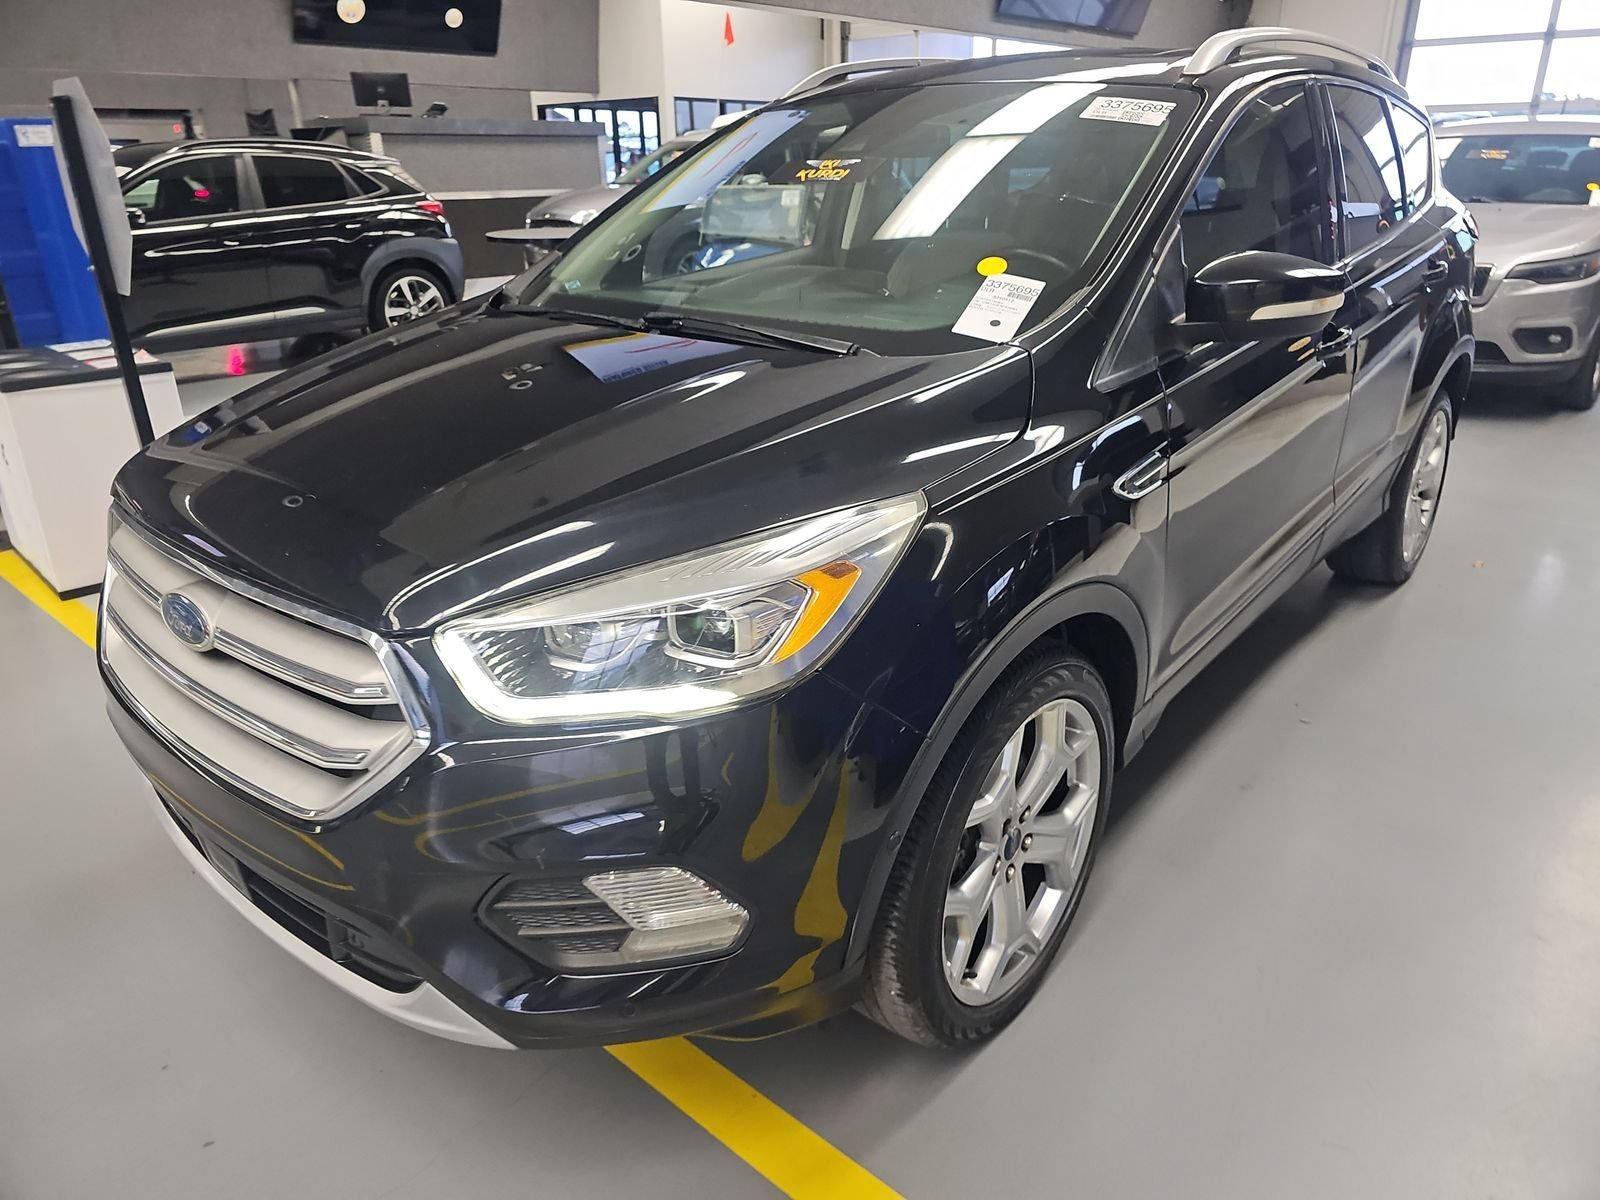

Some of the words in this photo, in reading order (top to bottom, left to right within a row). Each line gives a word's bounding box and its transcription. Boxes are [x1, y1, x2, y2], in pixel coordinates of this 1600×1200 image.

[1100, 99, 1175, 114] 3375695
[795, 168, 850, 181] KURDI
[985, 279, 1040, 296] 3375695
